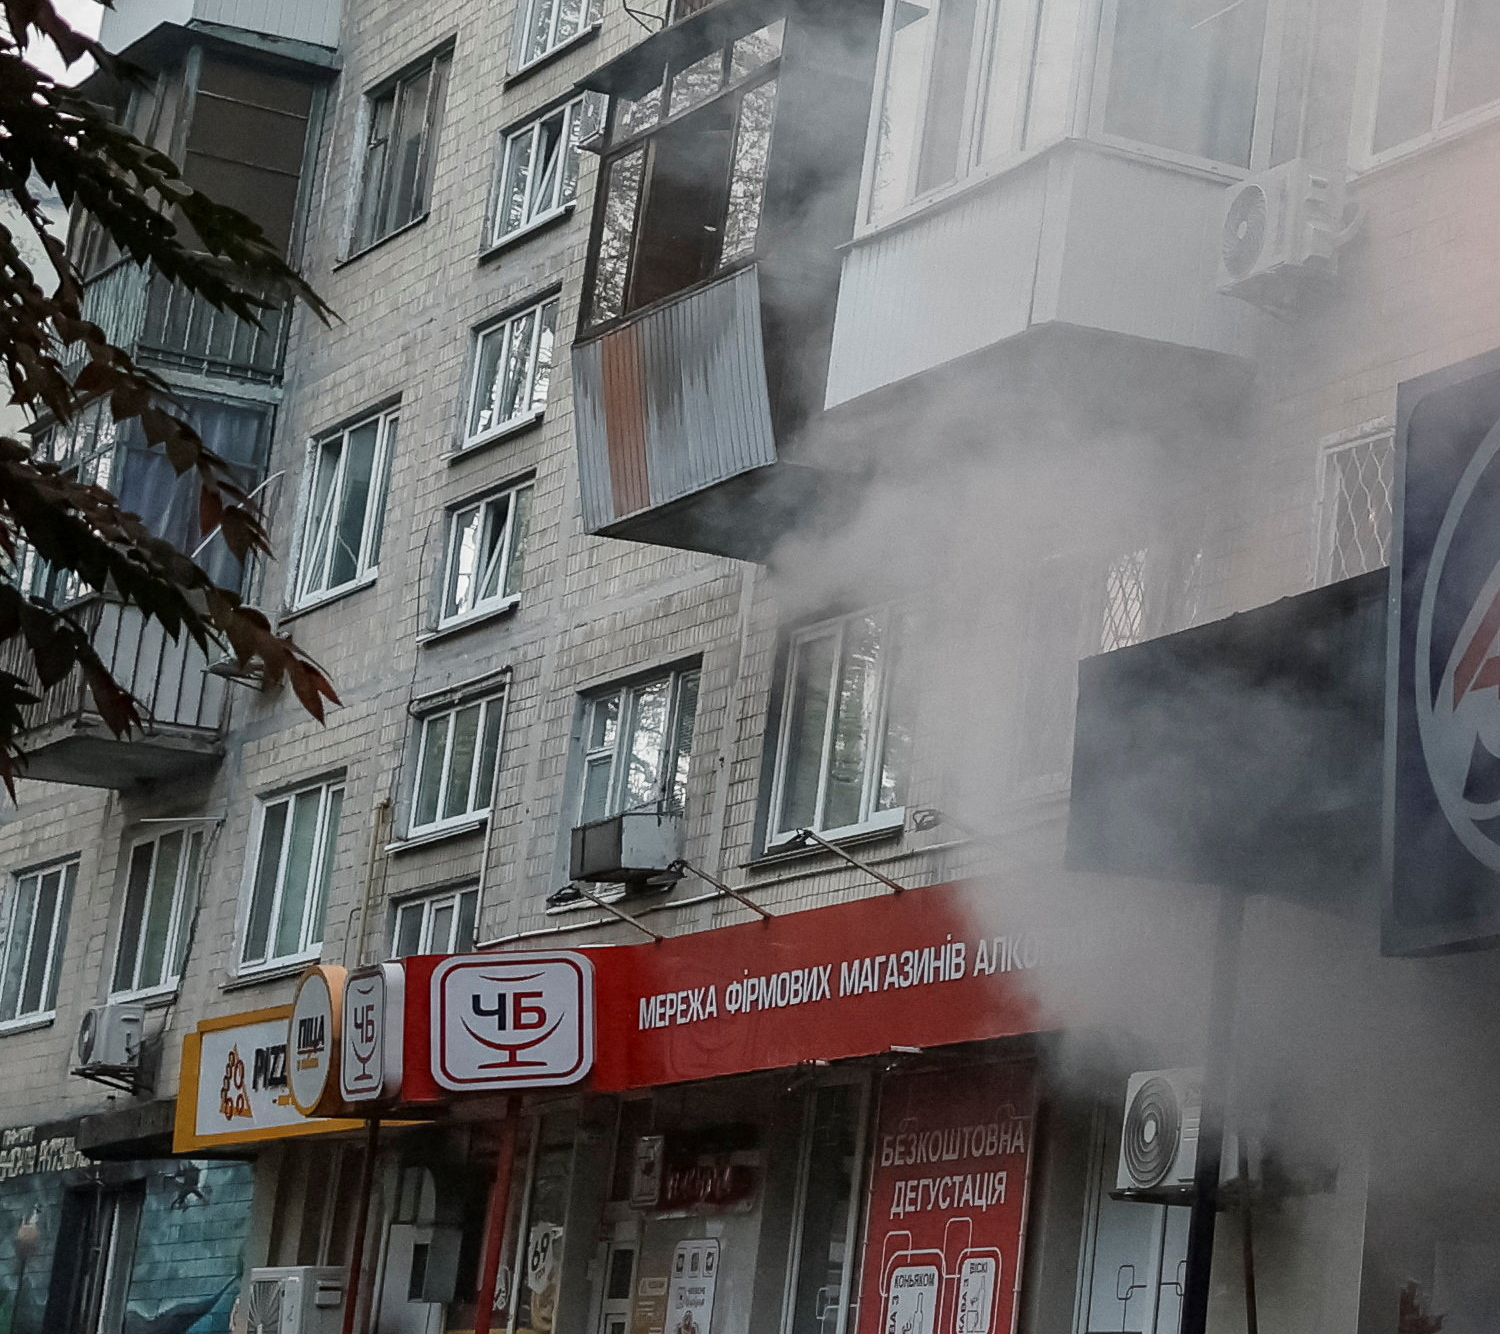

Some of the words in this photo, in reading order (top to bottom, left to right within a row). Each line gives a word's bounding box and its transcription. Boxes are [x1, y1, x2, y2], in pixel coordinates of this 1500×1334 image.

[354, 1004, 375, 1044] ЧБ
[472, 991, 547, 1031] ЧБ
[638, 984, 718, 1030] МЕРЕЖА
[297, 1015, 325, 1050] ПІЦА
[252, 1044, 288, 1092] PIZZ
[880, 1120, 1025, 1167] БЕЗКОШТОВНА
[889, 1170, 1007, 1220] ДЕГУСТАЦІЯ
[894, 1272, 936, 1288] КОНЬЯКОМ
